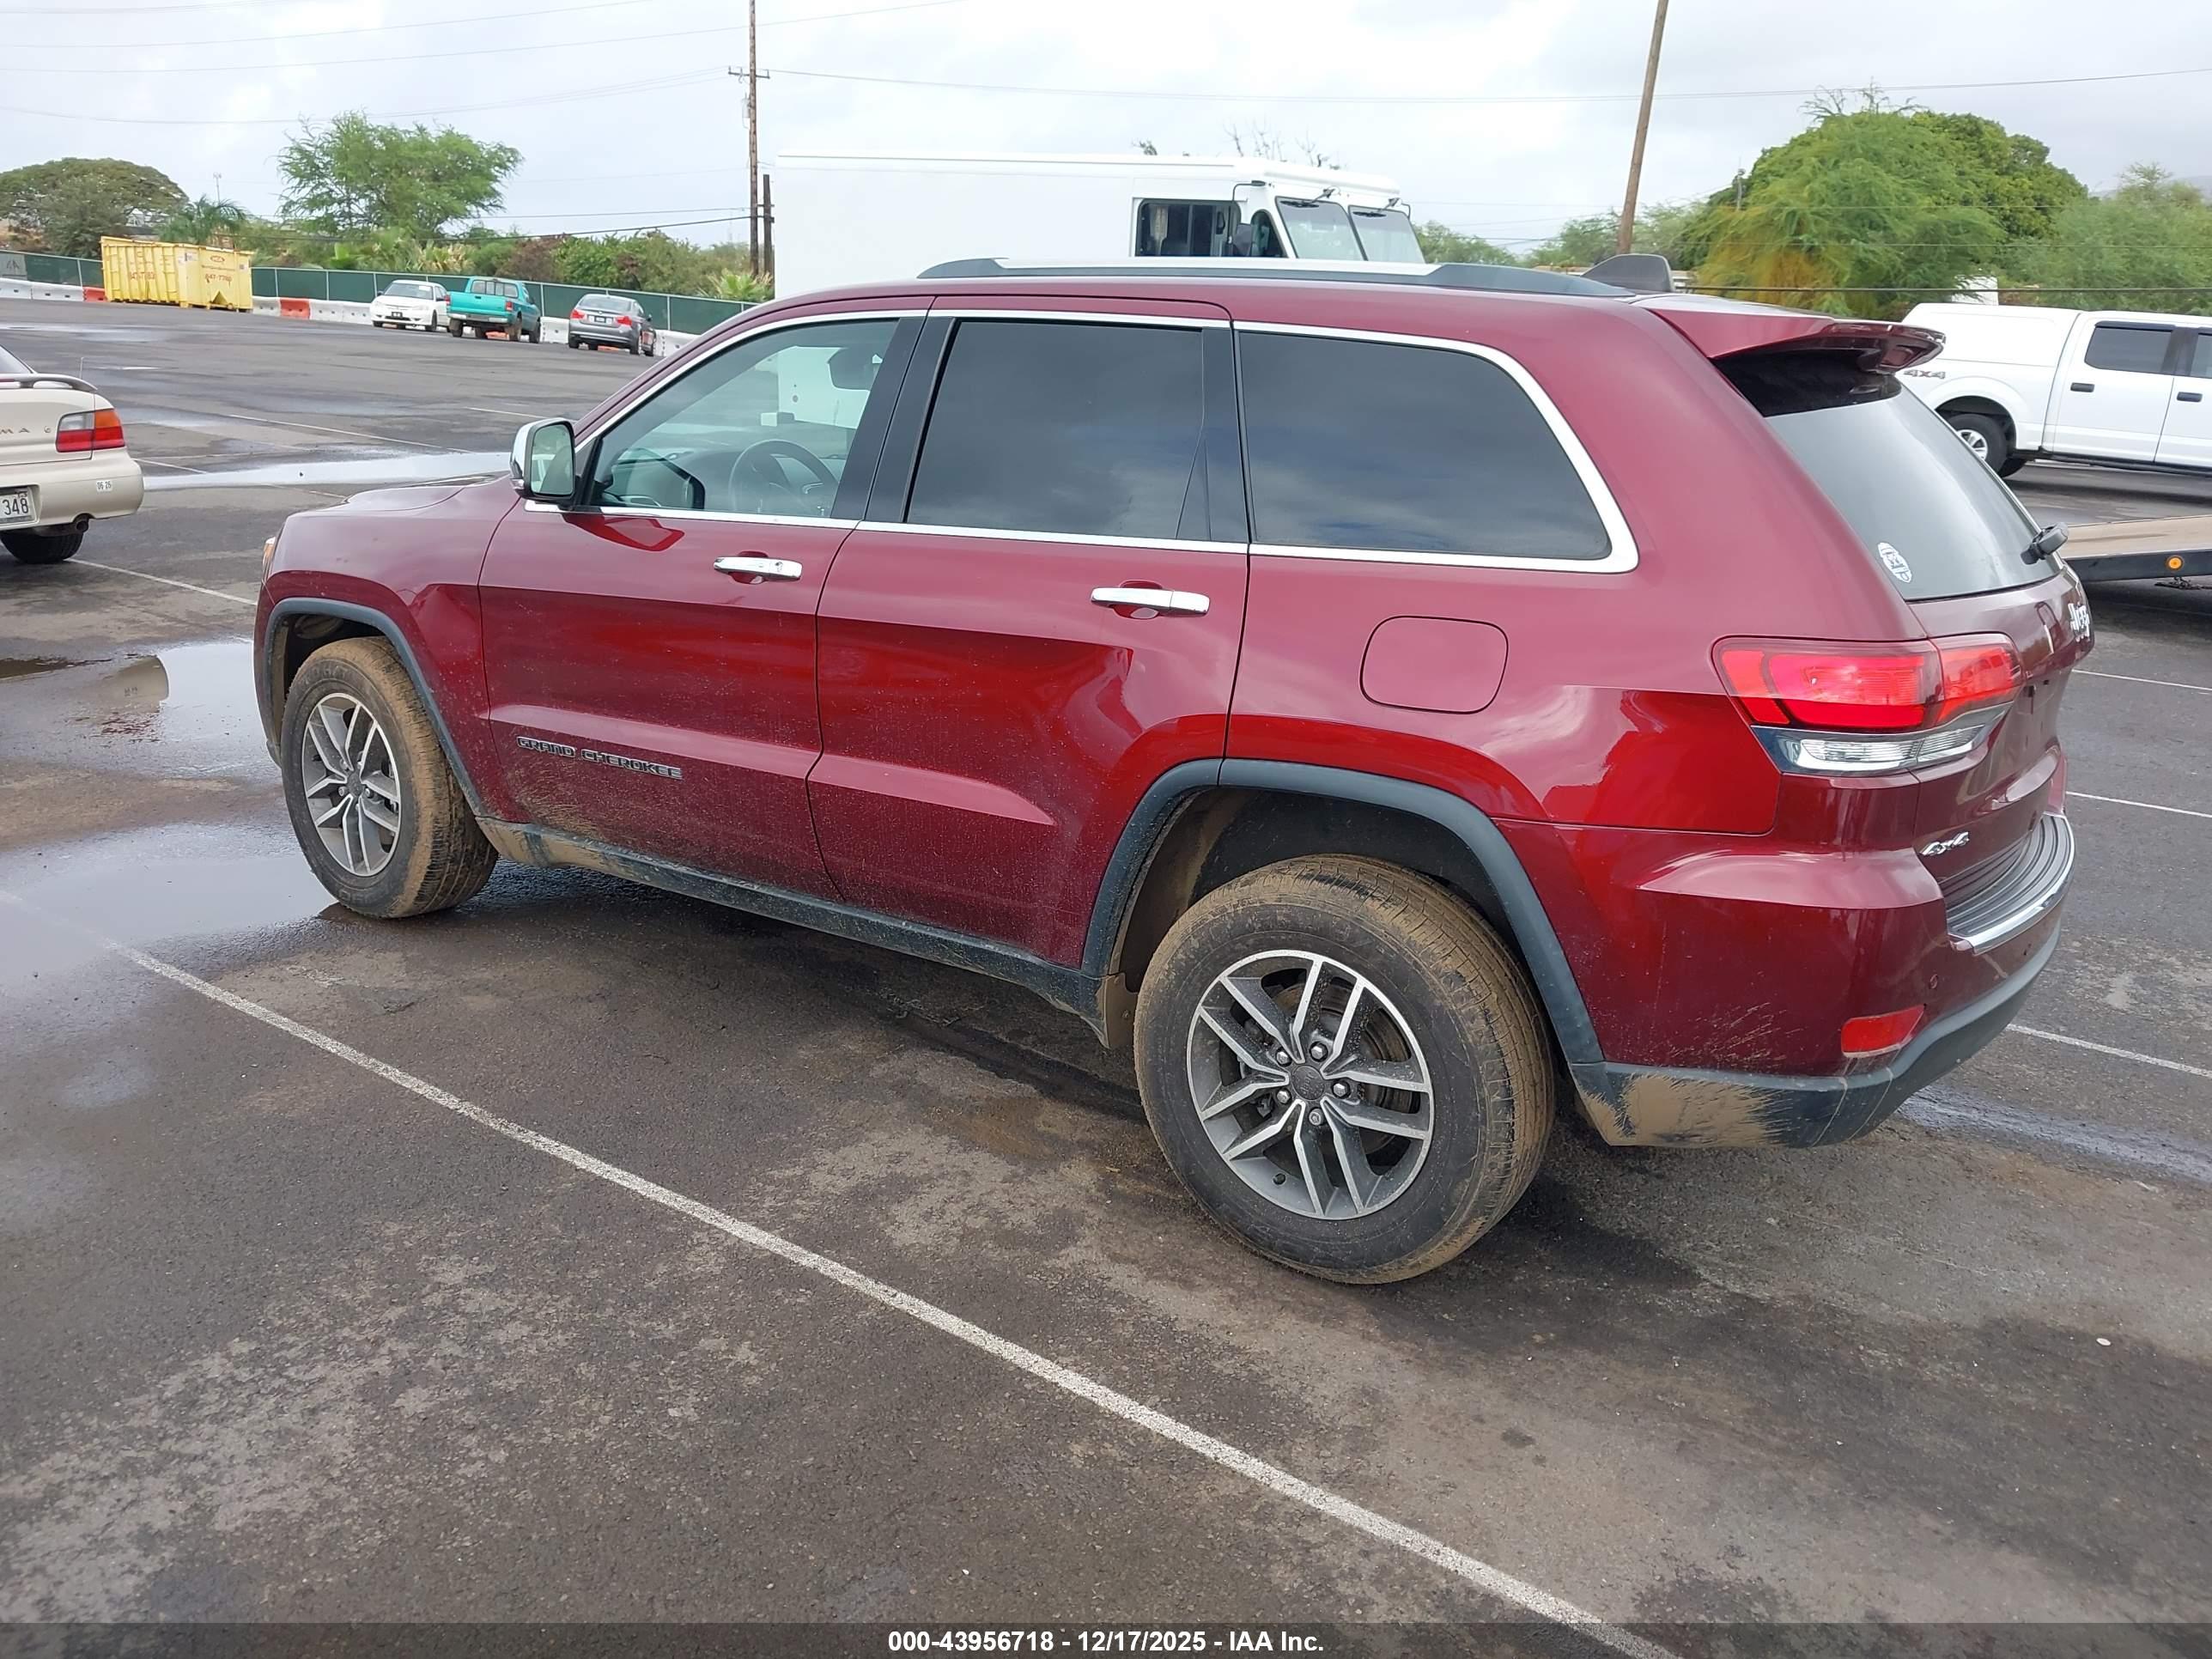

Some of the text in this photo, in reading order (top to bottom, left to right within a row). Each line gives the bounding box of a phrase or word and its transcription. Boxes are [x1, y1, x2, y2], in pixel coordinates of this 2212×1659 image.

[2, 497, 29, 515] 348
[516, 736, 684, 780] GRAND CHEROKEE
